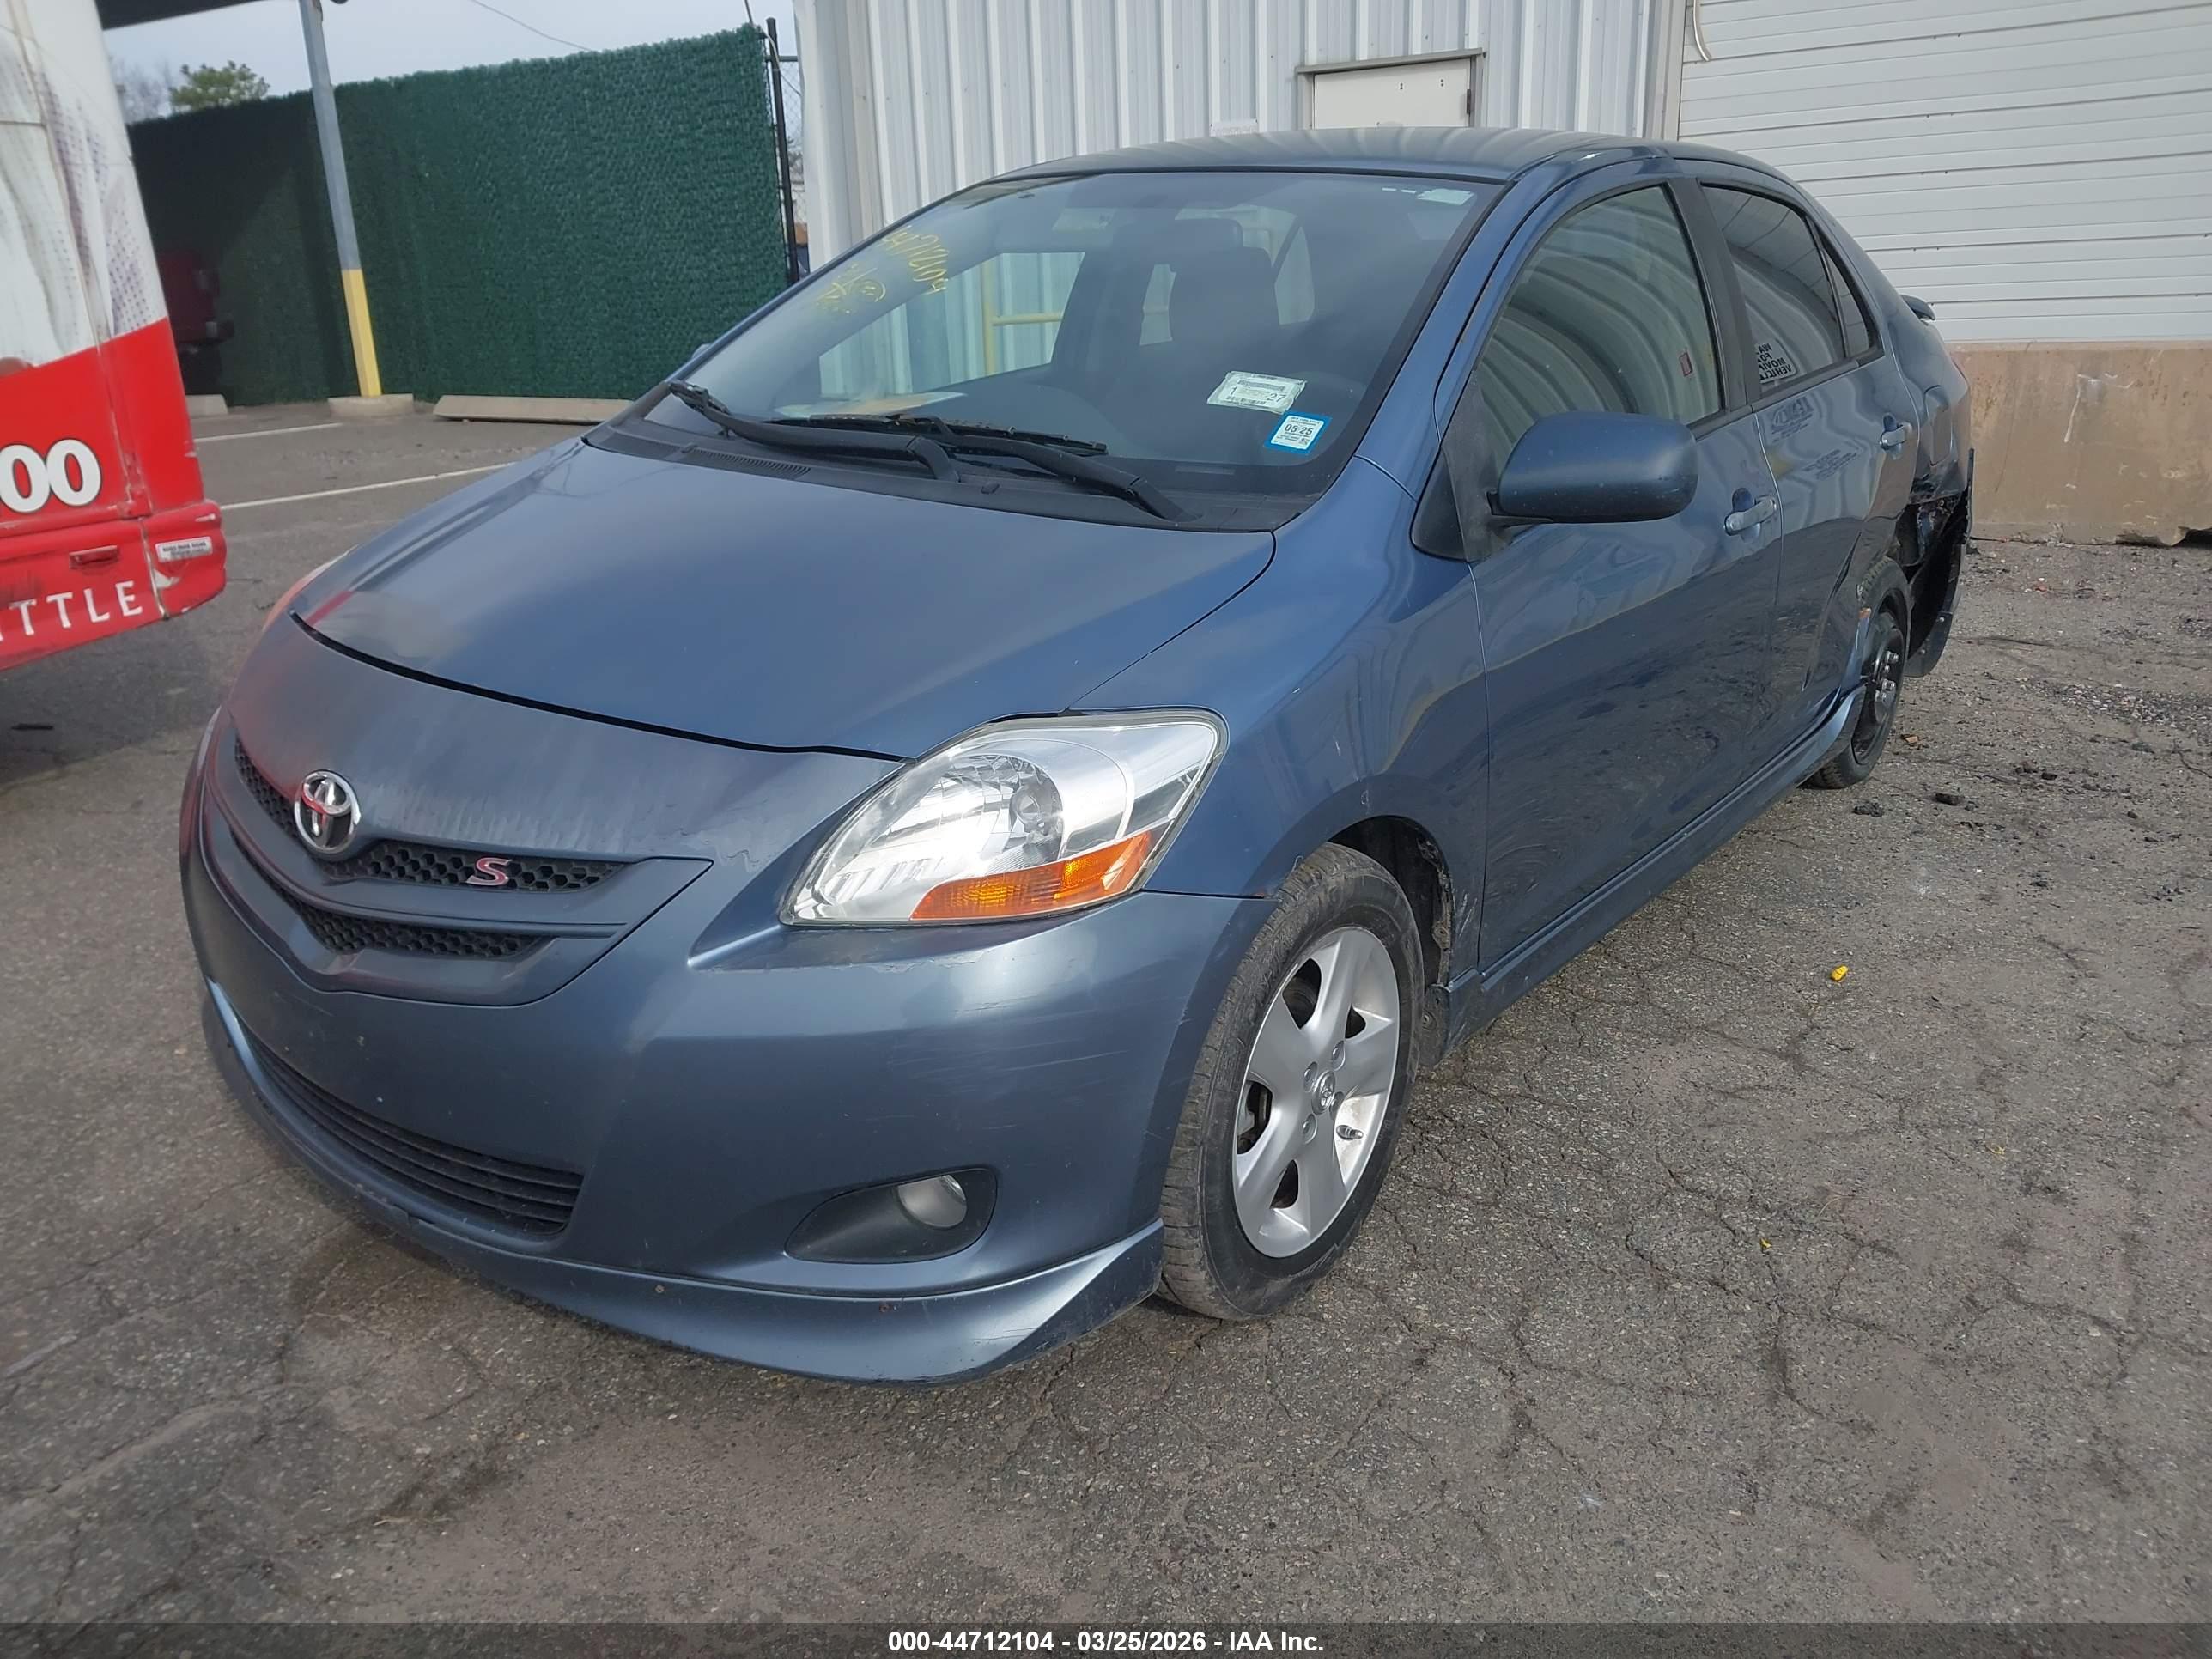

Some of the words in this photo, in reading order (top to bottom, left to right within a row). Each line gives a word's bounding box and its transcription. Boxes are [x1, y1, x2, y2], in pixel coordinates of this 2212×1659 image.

[1267, 392, 1287, 403] 27
[1285, 423, 1297, 433] 05
[1299, 426, 1314, 435] 25
[0, 437, 102, 514] 00
[0, 580, 143, 642] TTLE
[466, 856, 513, 887] S
